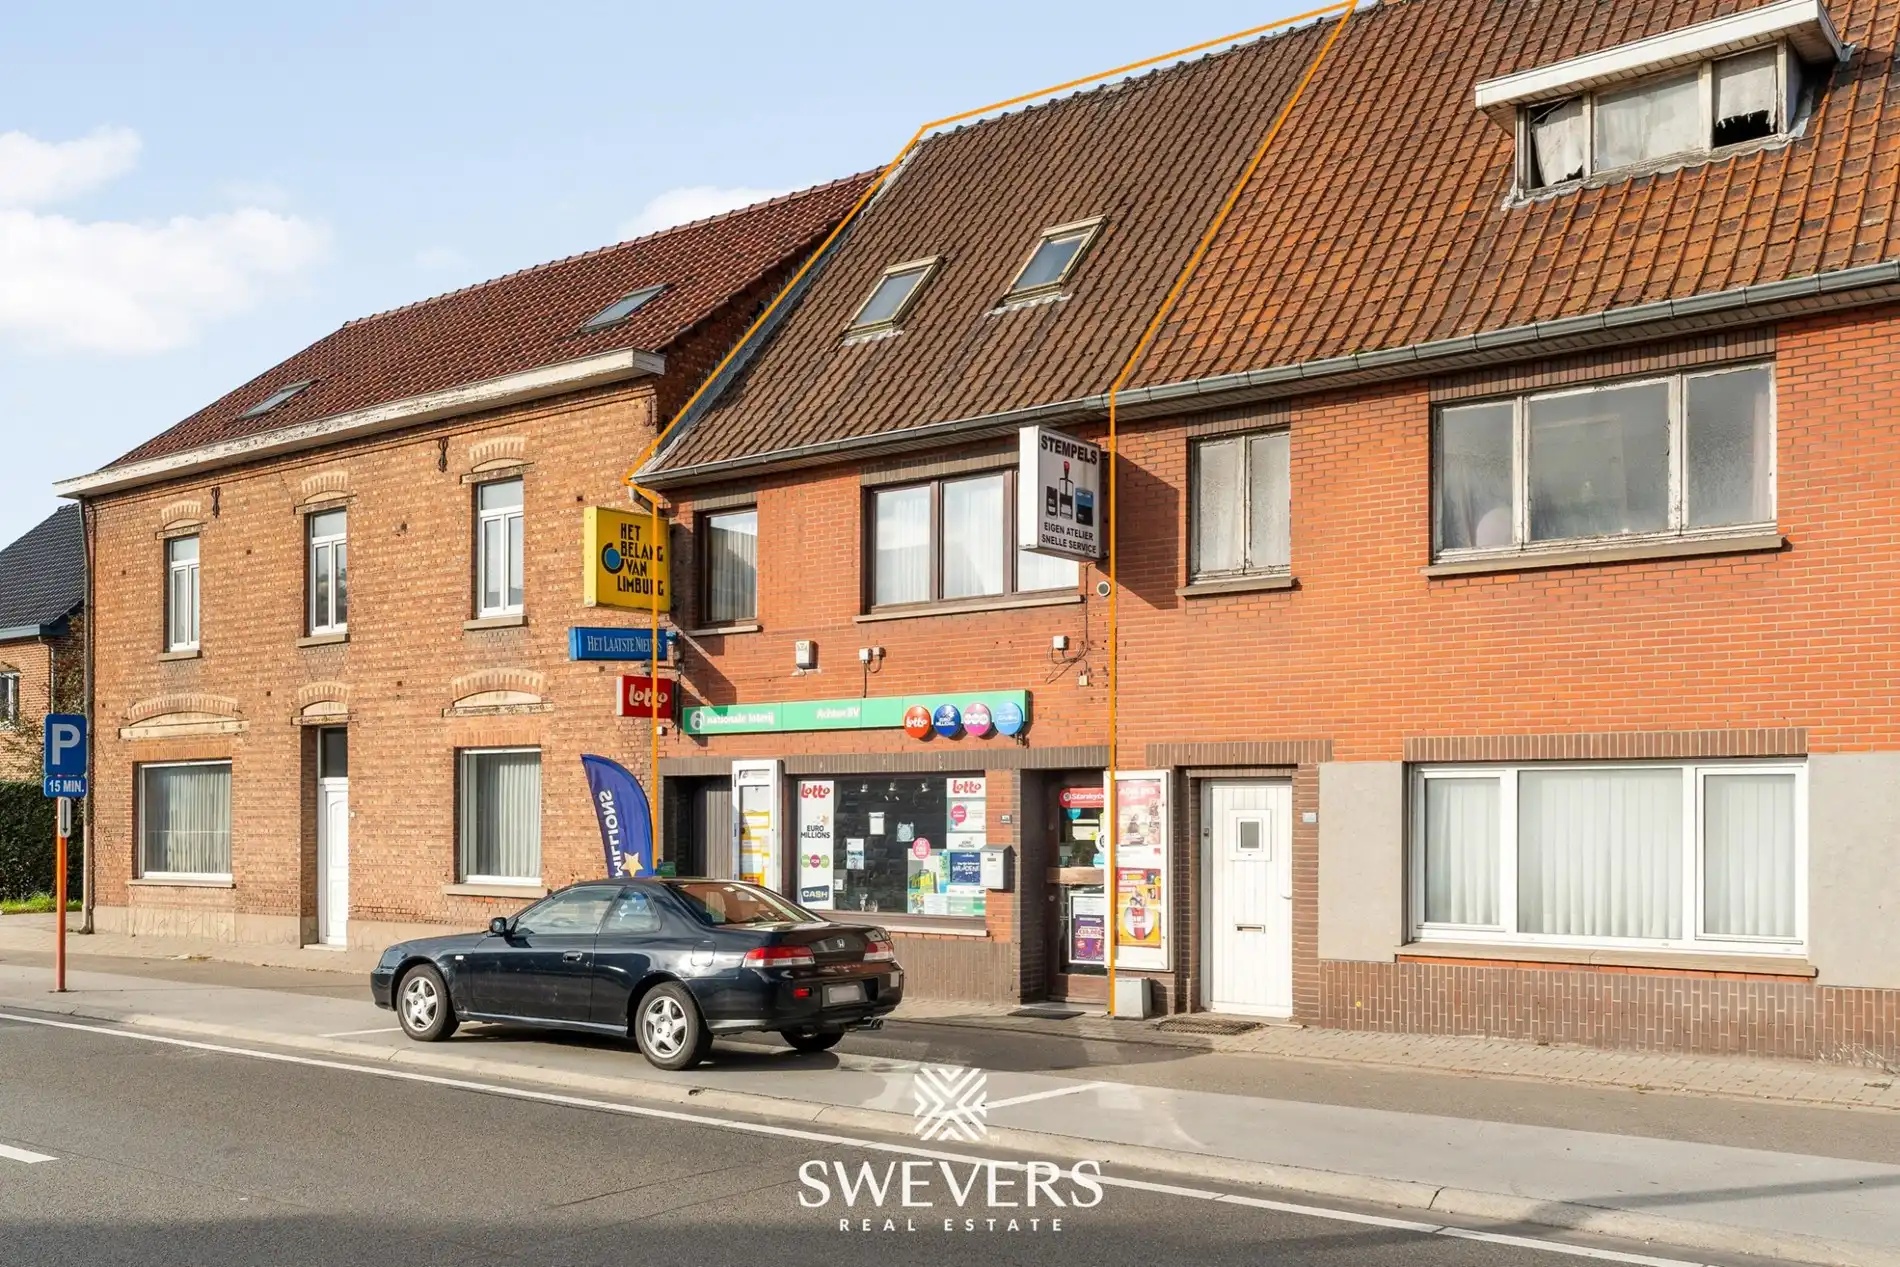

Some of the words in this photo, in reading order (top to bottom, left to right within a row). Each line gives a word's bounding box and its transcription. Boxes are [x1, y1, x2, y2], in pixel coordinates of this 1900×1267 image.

[1041, 435, 1098, 465] STEMPELS
[620, 523, 641, 541] HET
[1044, 522, 1065, 537] EIGEN
[1066, 528, 1094, 541] ATELIER
[1041, 534, 1067, 548] SNELLE
[1068, 540, 1097, 554] SERVICE
[626, 558, 647, 577] VAN
[635, 636, 662, 652] NIEUS
[52, 723, 80, 765] P
[49, 780, 60, 793] 15
[63, 780, 85, 793] MIN.
[800, 831, 831, 839] MILLIONS
[802, 889, 828, 898] CASH
